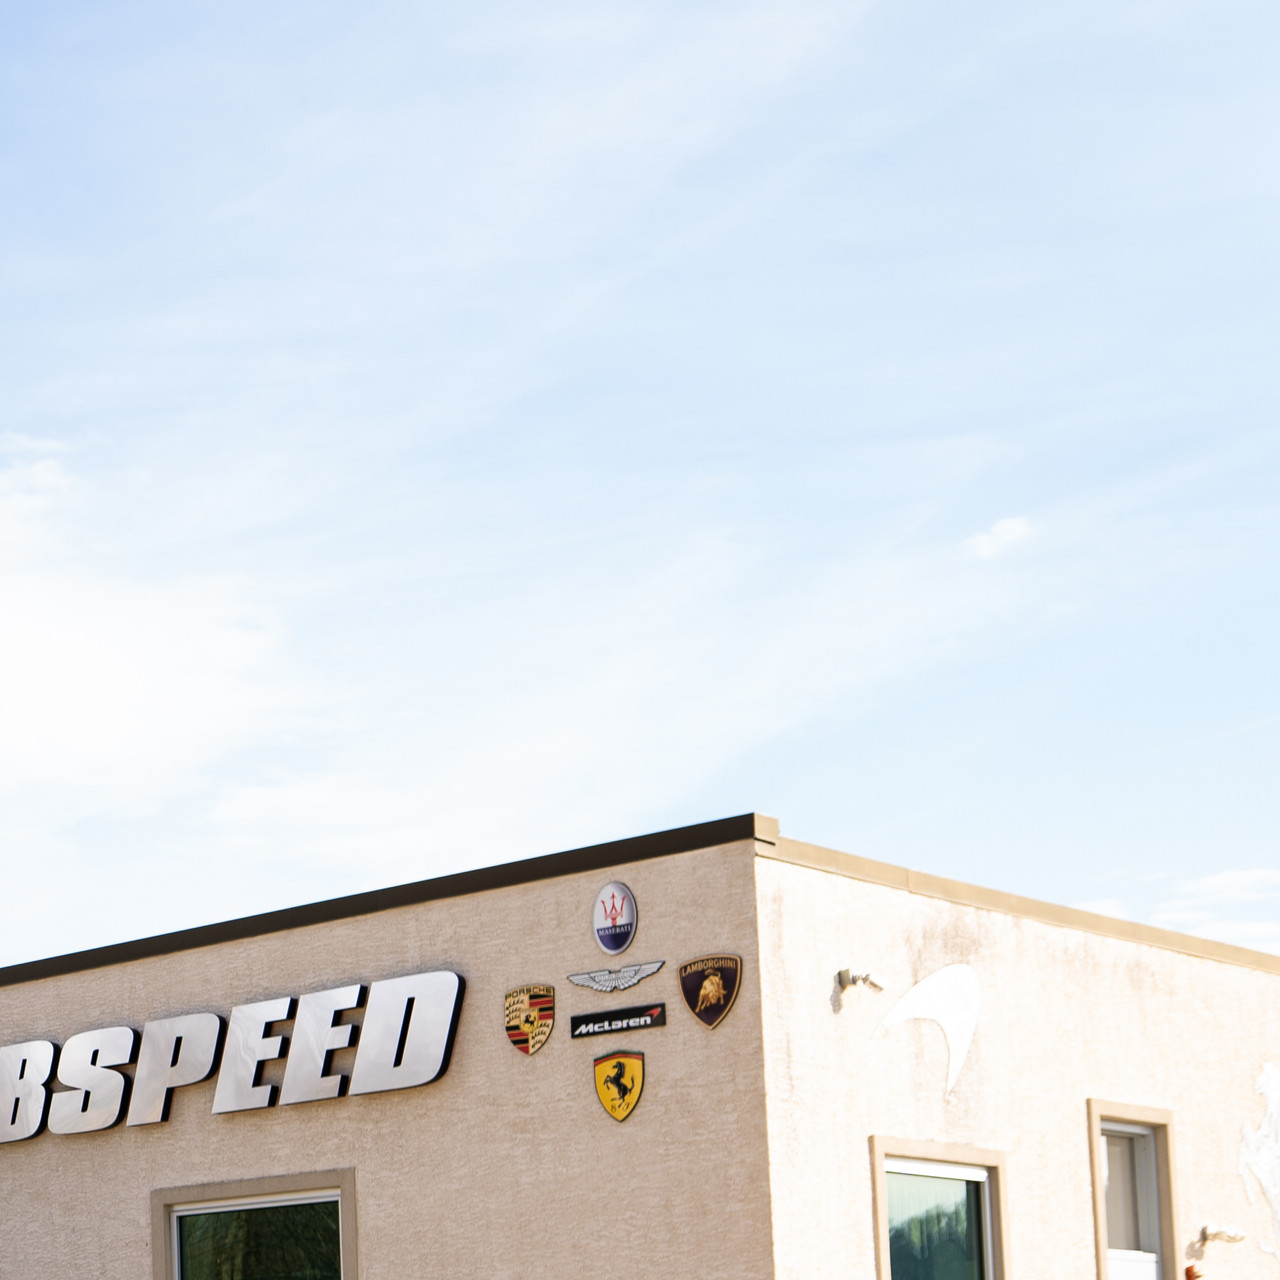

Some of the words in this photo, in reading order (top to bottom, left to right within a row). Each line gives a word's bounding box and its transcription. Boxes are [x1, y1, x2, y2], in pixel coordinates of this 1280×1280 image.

[598, 924, 631, 936] MASERATI
[682, 958, 736, 977] LAMBORGHINI
[504, 986, 552, 1001] PORSCHE
[573, 1015, 652, 1036] McLaren
